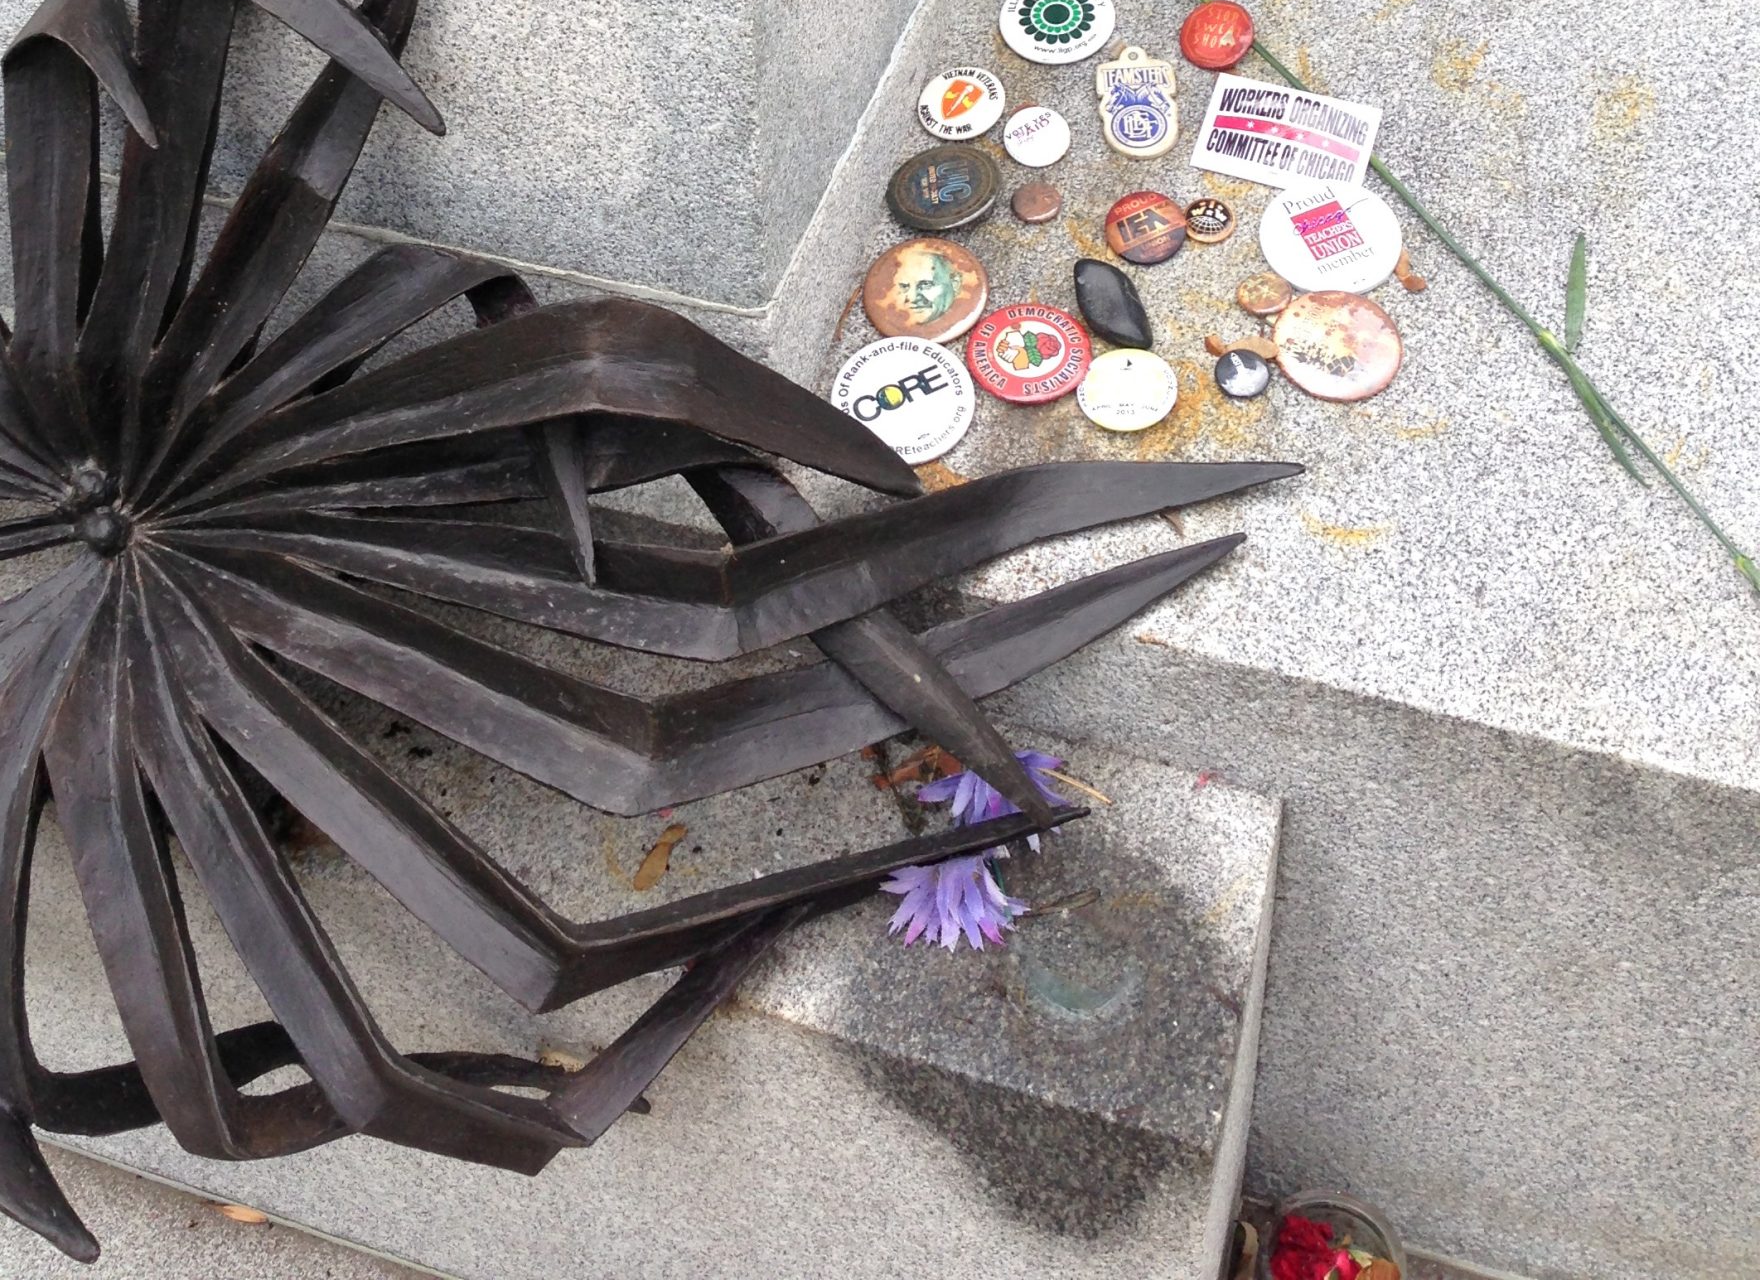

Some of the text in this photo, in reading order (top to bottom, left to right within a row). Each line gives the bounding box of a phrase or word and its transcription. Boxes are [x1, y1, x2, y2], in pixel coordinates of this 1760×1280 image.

[1207, 6, 1240, 23] STOP
[942, 69, 999, 101] VIETNAM VETERANS
[1100, 65, 1172, 92] TEAMSTERS
[919, 104, 973, 135] AGAINST THE WAR
[1005, 111, 1051, 140] VOTE YES
[1219, 87, 1369, 146] WORKERS ORGANIZING
[1206, 128, 1355, 183] COMMITTEE OF CHICAGO
[1114, 192, 1159, 216] PROUD
[1282, 186, 1336, 215] Proud
[1303, 220, 1354, 246] TEACHERS
[1310, 230, 1363, 259] UNION
[1317, 247, 1375, 275] member
[973, 322, 1007, 390] OF AMERICA
[1007, 307, 1083, 396] DEMOCRATIC SOCIALISTS
[838, 340, 964, 398] Of Rank-and-file Educators
[852, 363, 950, 422] CORE
